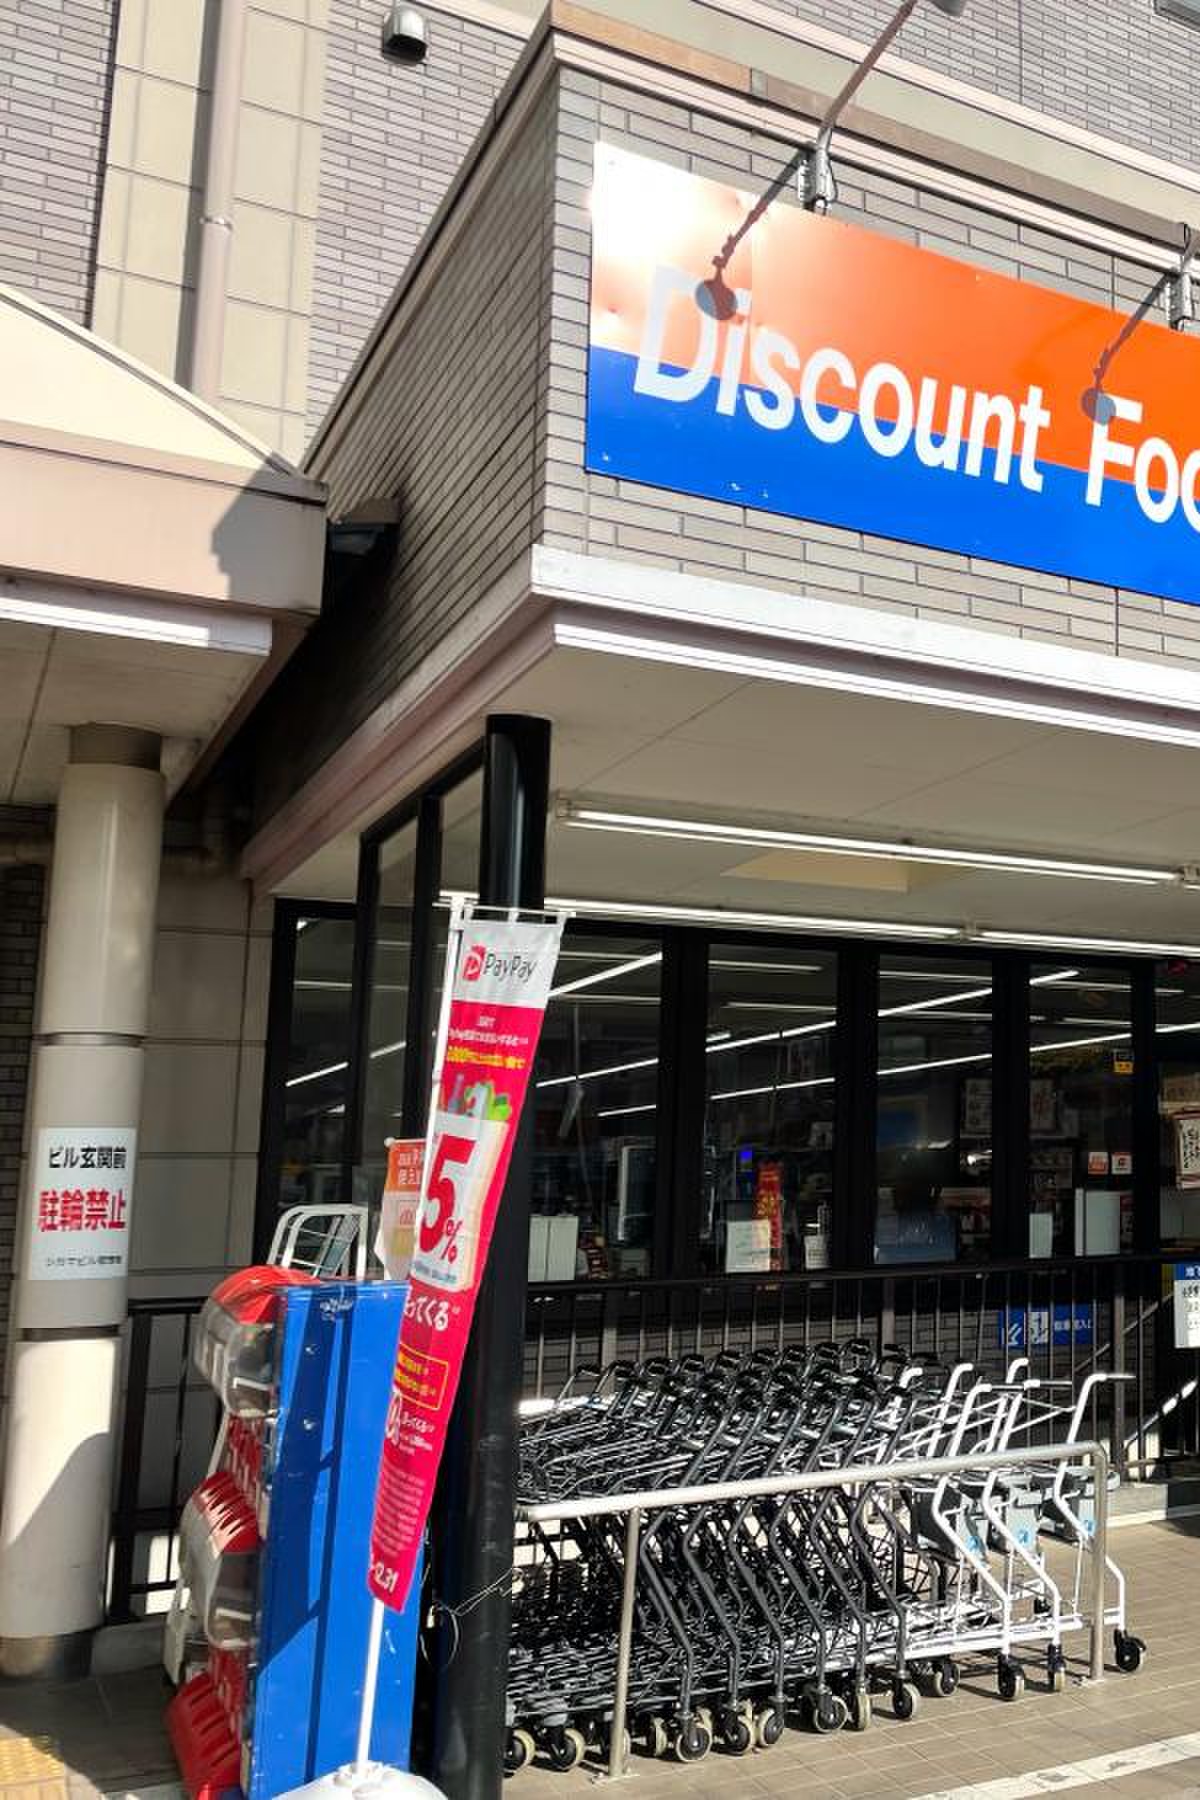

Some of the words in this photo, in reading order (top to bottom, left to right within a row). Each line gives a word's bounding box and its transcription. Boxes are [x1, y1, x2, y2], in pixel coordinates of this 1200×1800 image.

[634, 265, 1050, 493] Discount
[49, 1147, 127, 1168] ビル玄関前
[38, 1189, 127, 1232] 駐輪禁止
